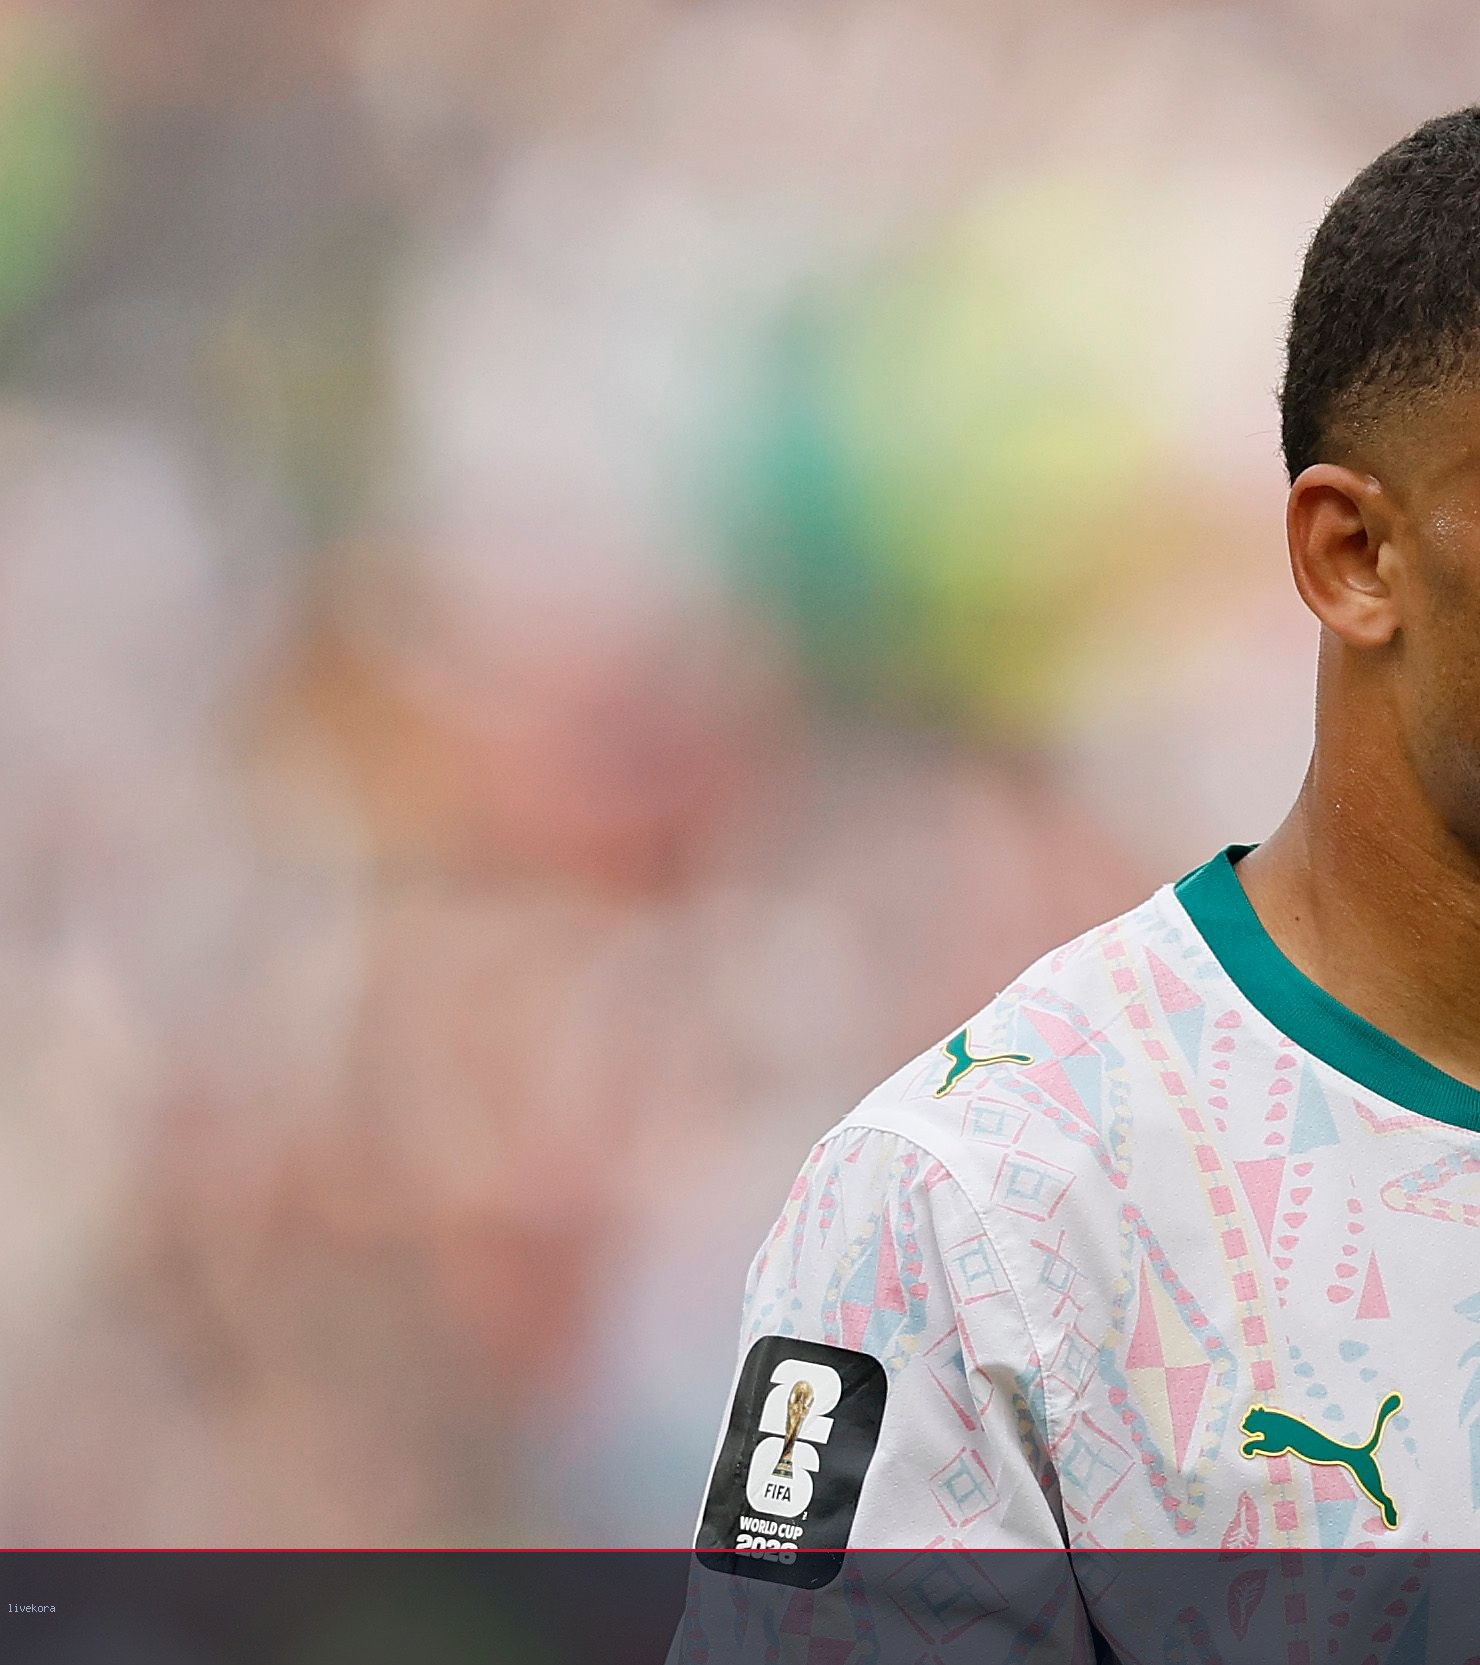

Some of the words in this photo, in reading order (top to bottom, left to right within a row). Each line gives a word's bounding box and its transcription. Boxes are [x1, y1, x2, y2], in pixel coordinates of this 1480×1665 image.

[763, 1482, 792, 1503] FIFA
[739, 1515, 778, 1536] WORLD
[778, 1523, 804, 1541] CUP
[735, 1533, 799, 1565] 2026
